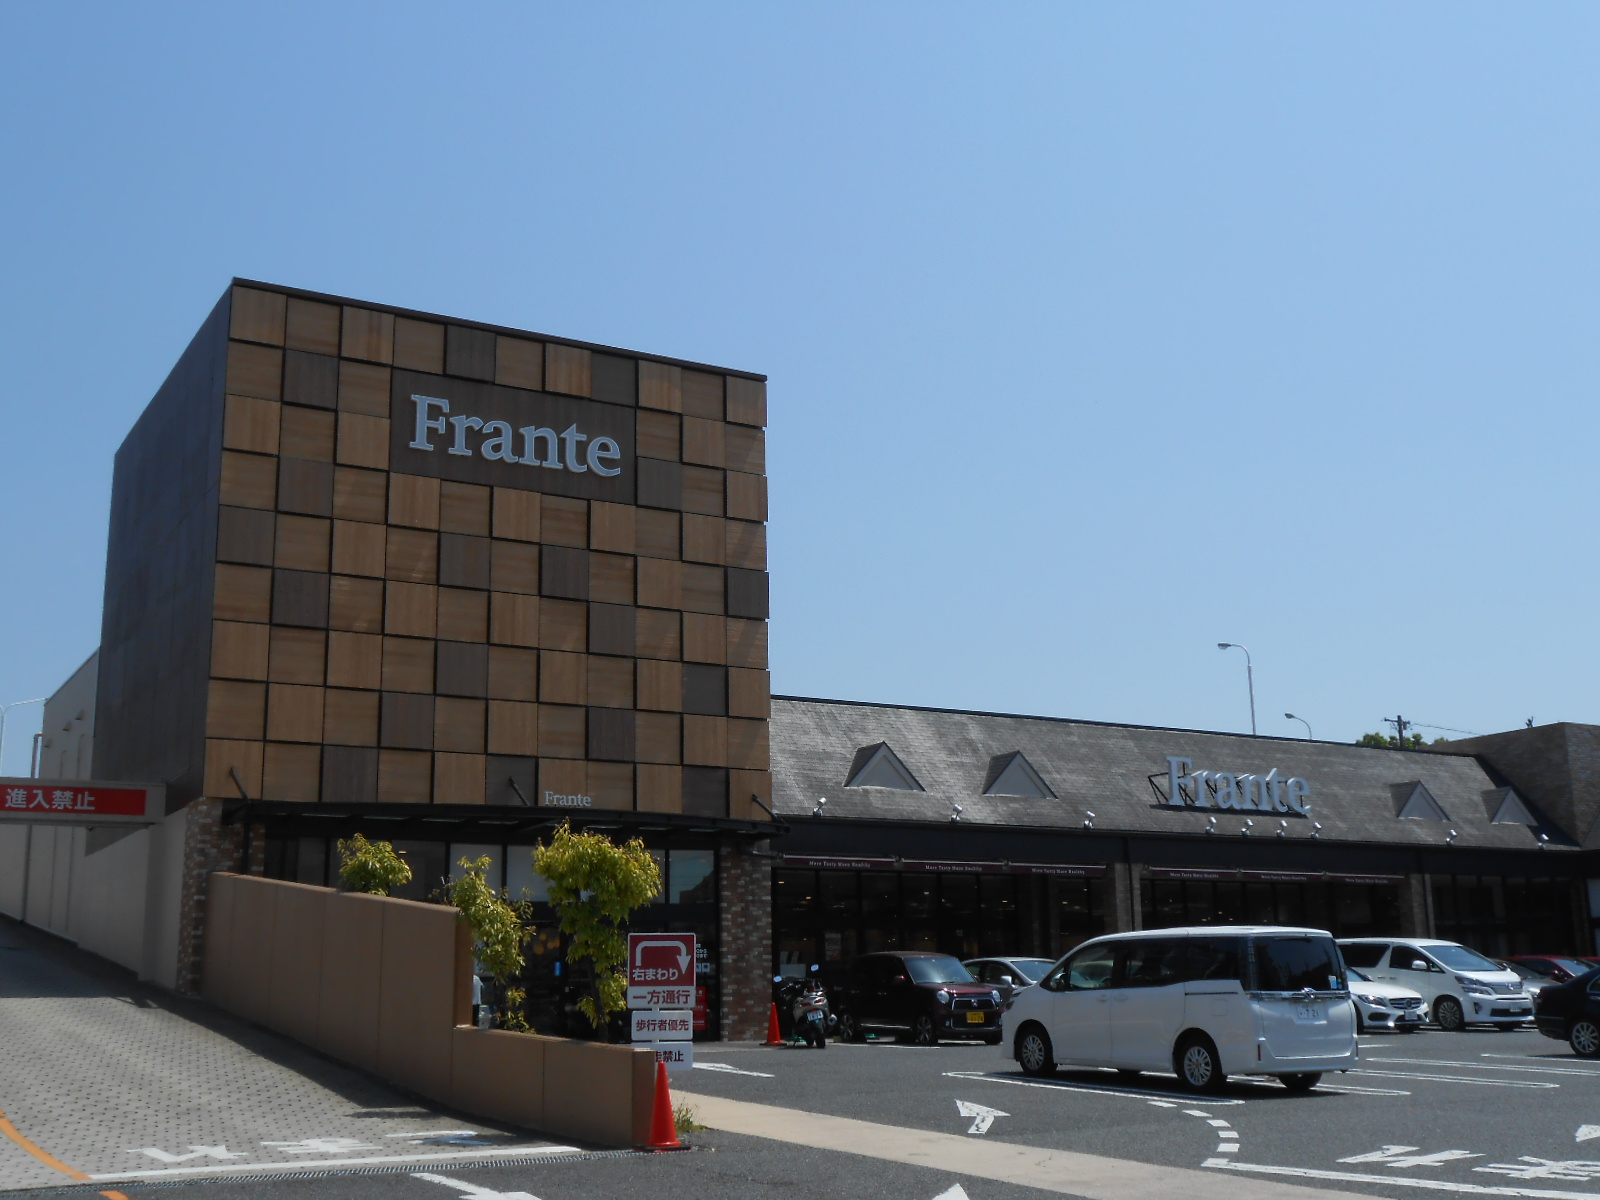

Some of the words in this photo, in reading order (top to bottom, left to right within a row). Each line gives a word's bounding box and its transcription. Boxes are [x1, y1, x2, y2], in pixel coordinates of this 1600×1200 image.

[409, 394, 621, 477] Frante
[1165, 755, 1313, 815] Frante
[5, 788, 96, 811] 進入禁止
[544, 790, 592, 807] Frante
[632, 968, 679, 981] 右まわり
[632, 989, 691, 1005] 一方通行
[636, 1019, 689, 1032] 歩行者優先
